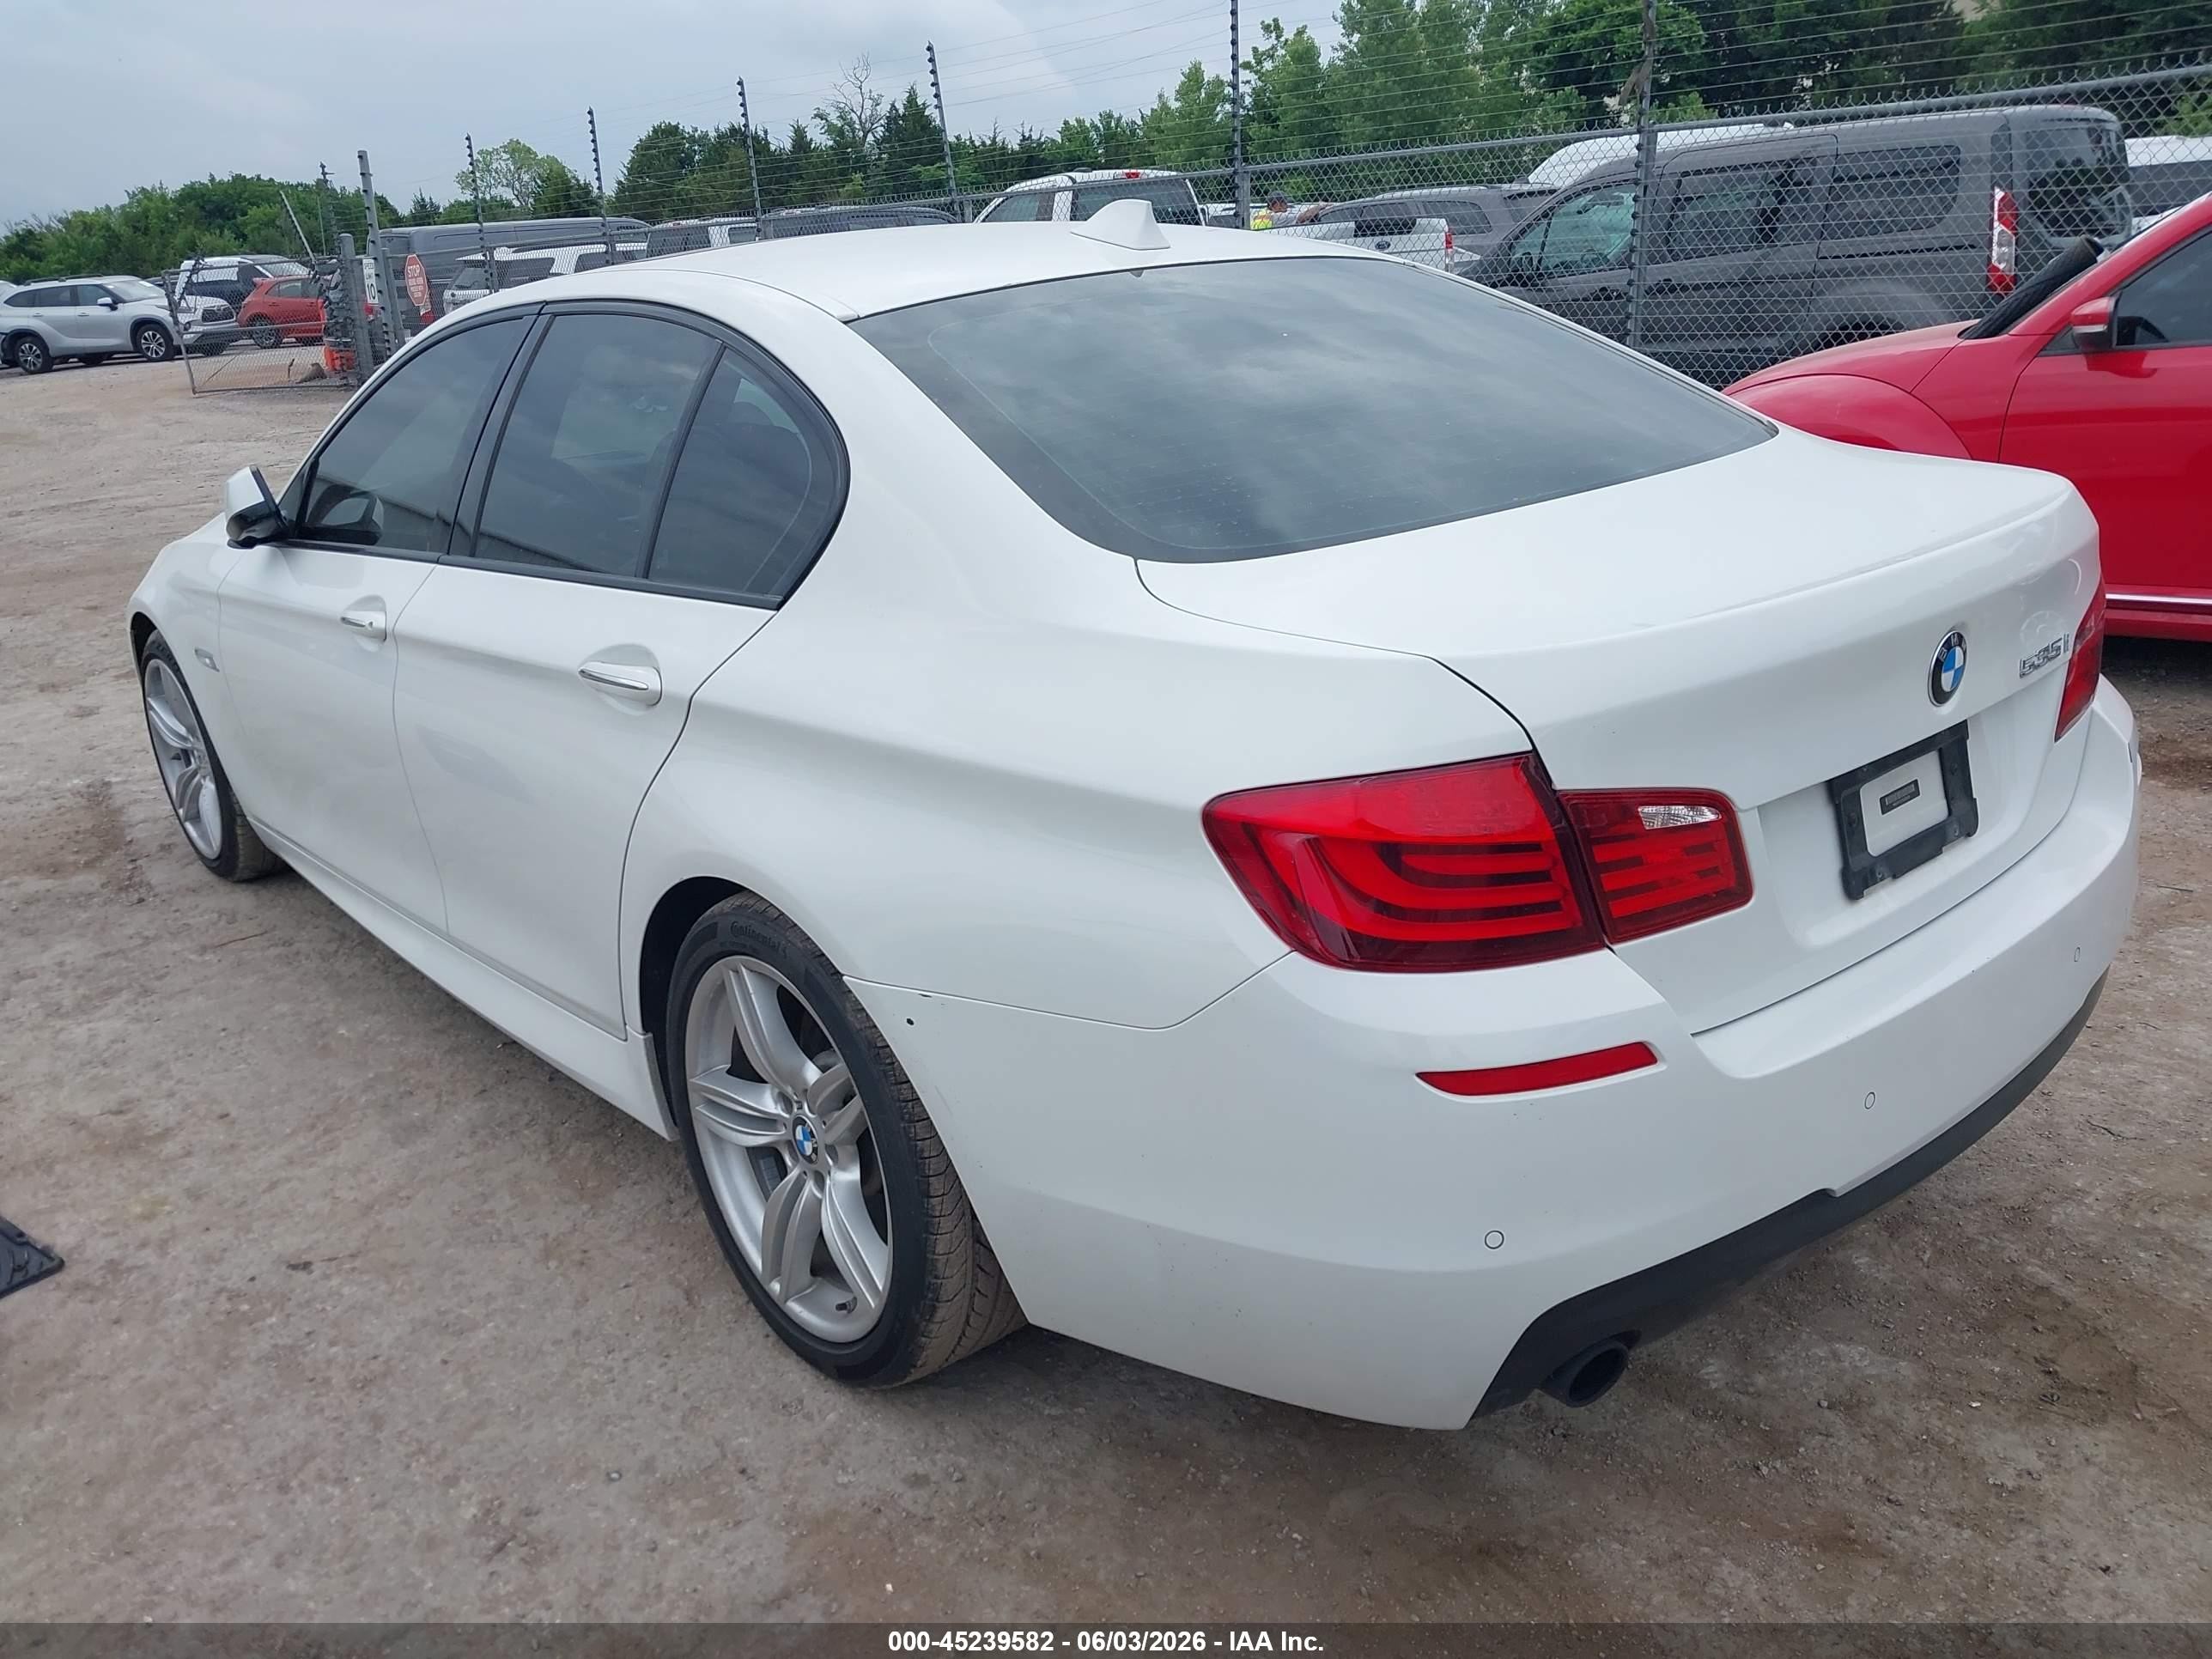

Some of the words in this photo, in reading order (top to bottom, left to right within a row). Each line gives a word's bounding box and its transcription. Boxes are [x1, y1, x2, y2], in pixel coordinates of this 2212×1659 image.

[408, 264, 421, 277] STOP
[367, 283, 376, 300] 10
[1938, 633, 1966, 662] BMW
[2019, 634, 2069, 679] 535i
[730, 921, 781, 955] Continental
